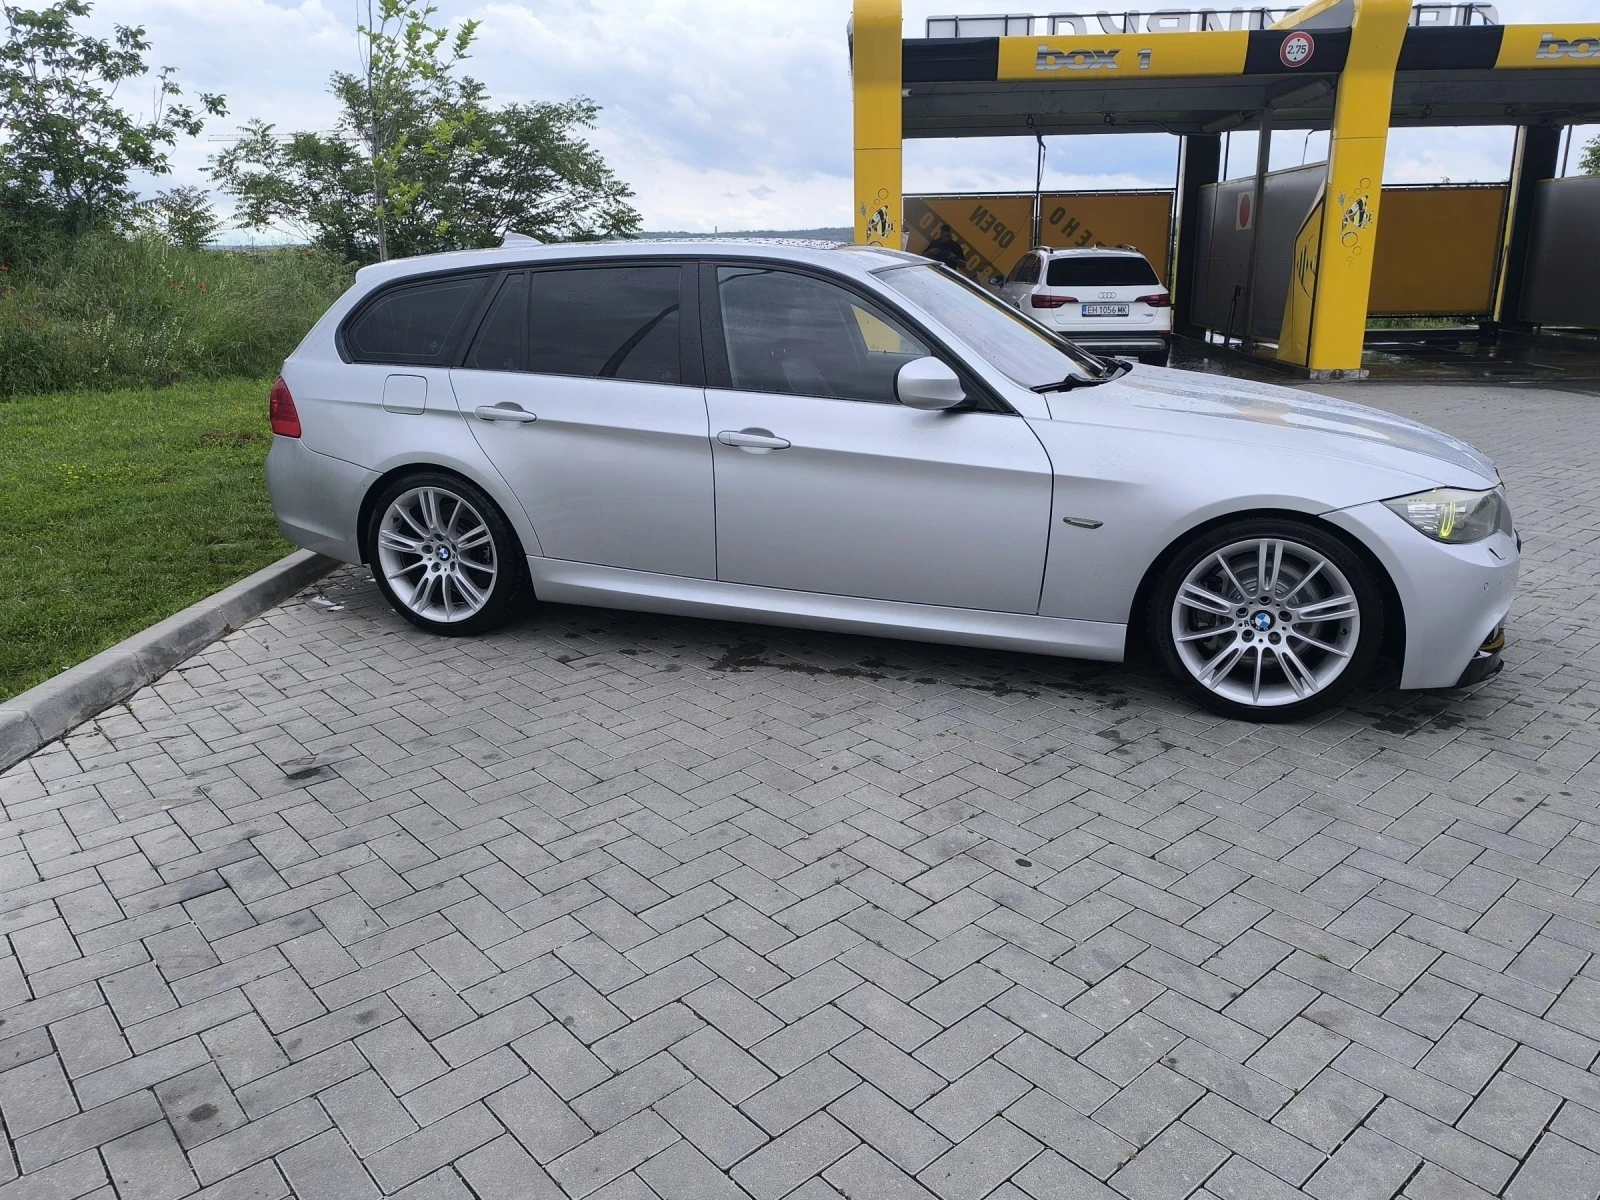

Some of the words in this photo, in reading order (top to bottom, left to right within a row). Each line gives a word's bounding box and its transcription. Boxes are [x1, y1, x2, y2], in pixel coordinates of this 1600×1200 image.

[1287, 44, 1307, 55] 2.75
[1535, 31, 1600, 59] bo
[1035, 44, 1121, 71] box
[1137, 48, 1152, 69] 1
[1087, 306, 1098, 314] EH
[1099, 306, 1117, 314] 1056
[1117, 306, 1127, 314] MK
